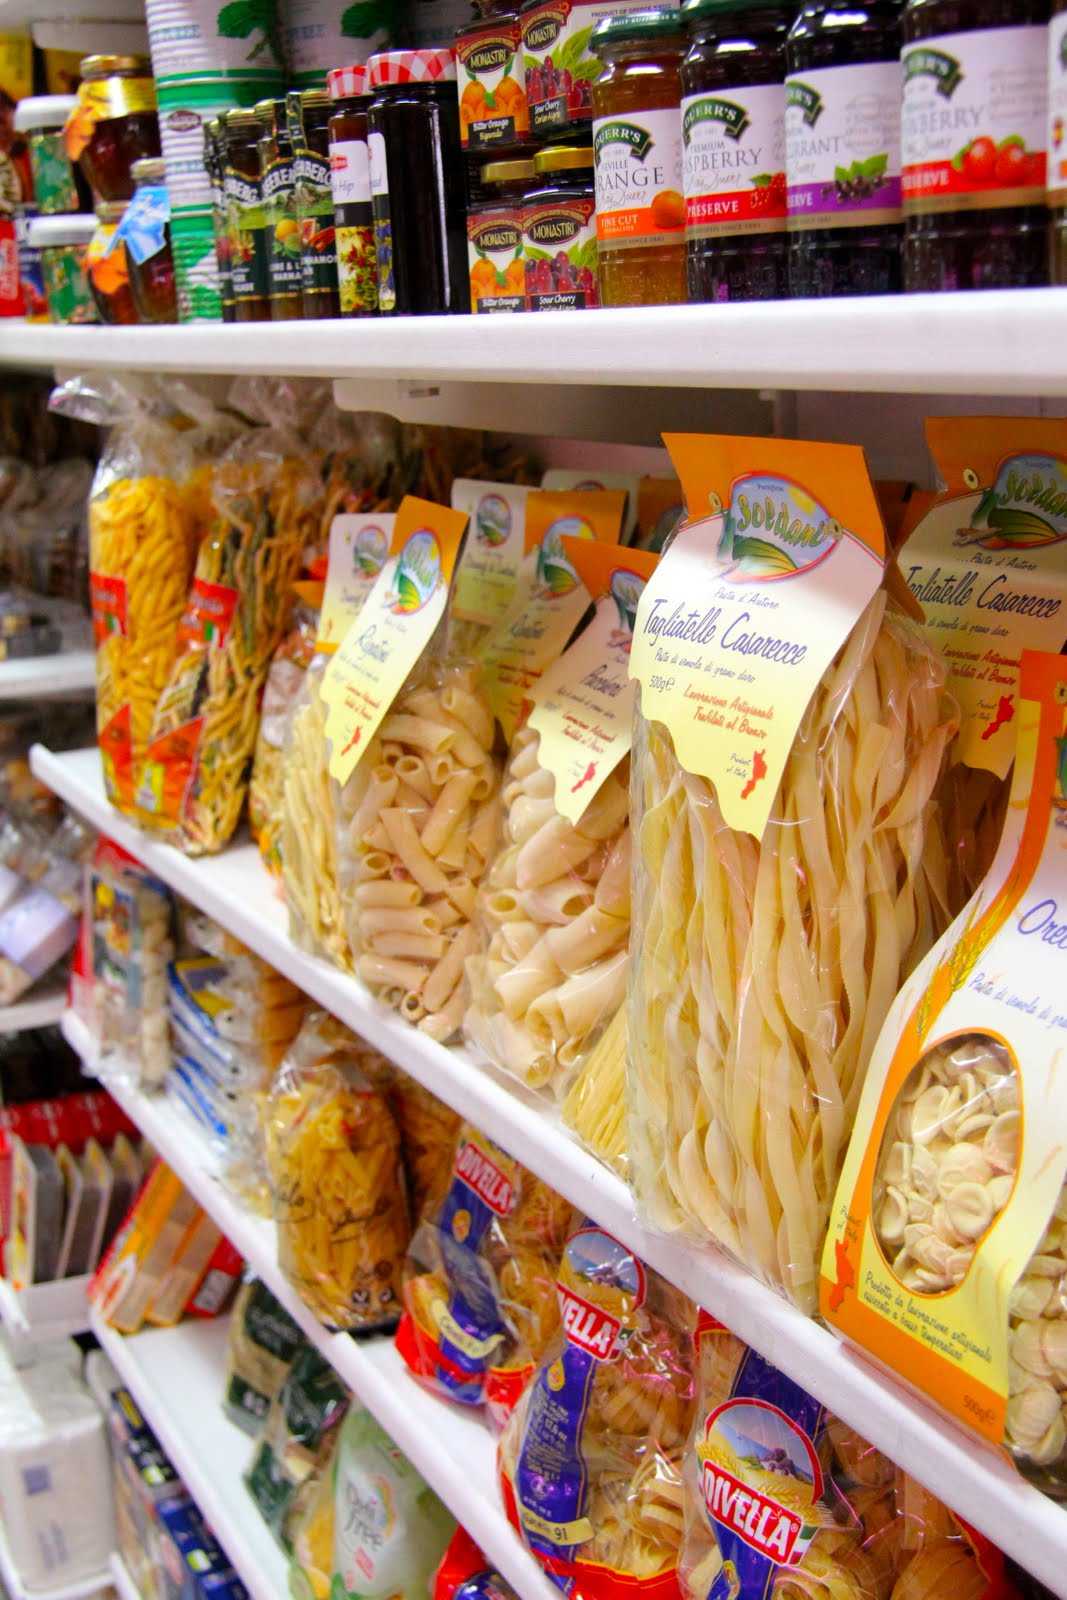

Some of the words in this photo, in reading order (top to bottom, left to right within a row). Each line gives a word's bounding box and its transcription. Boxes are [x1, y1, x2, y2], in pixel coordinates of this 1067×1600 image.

[591, 9, 619, 18] PRODUCT
[527, 22, 558, 47] MONASTIRI
[470, 48, 507, 69] MONASTIRI
[534, 102, 545, 115] Sour
[544, 100, 560, 112] Cherry
[488, 118, 509, 131] Orange
[595, 167, 665, 193] RANGE
[687, 199, 740, 218] PRESERVE
[533, 221, 576, 240] MONASTIRI
[601, 217, 616, 228] FINE
[617, 214, 639, 225] CUT
[479, 231, 518, 247] MONASTIRI
[539, 296, 555, 305] Sour
[554, 294, 577, 304] Cherry
[714, 586, 736, 601] Pasta
[976, 574, 1063, 619] Casarecce
[643, 598, 723, 647] Tagliatelle
[720, 611, 808, 666] Casarecce
[936, 616, 960, 630] semola
[960, 620, 969, 632] di
[968, 625, 991, 636] grano
[990, 624, 1010, 637] duro
[654, 647, 670, 662] Pasta
[670, 652, 679, 664] di
[678, 656, 703, 670] semola
[703, 661, 713, 673] di
[711, 667, 737, 679] grano
[736, 669, 756, 684] duro
[976, 667, 990, 681] al
[988, 668, 1017, 686] Bronzo
[683, 683, 728, 708] Lavorazione
[728, 696, 775, 721] Artigianale
[693, 706, 725, 727] Trafilati
[725, 716, 740, 731] al
[738, 718, 768, 740] Bronzo
[730, 752, 752, 766] Product
[725, 765, 735, 774] of
[733, 766, 748, 780] Italy
[968, 972, 994, 996] Pasta
[993, 986, 1008, 1001] di
[1005, 996, 1040, 1016] semola
[1037, 1004, 1051, 1021] di
[457, 1146, 512, 1211] DIVELLA
[864, 1270, 893, 1301] Prodotto
[895, 1294, 904, 1307] da
[906, 1298, 949, 1335] lavorazione
[703, 1466, 792, 1557] DIVELLA
[554, 1526, 569, 1541] 91
